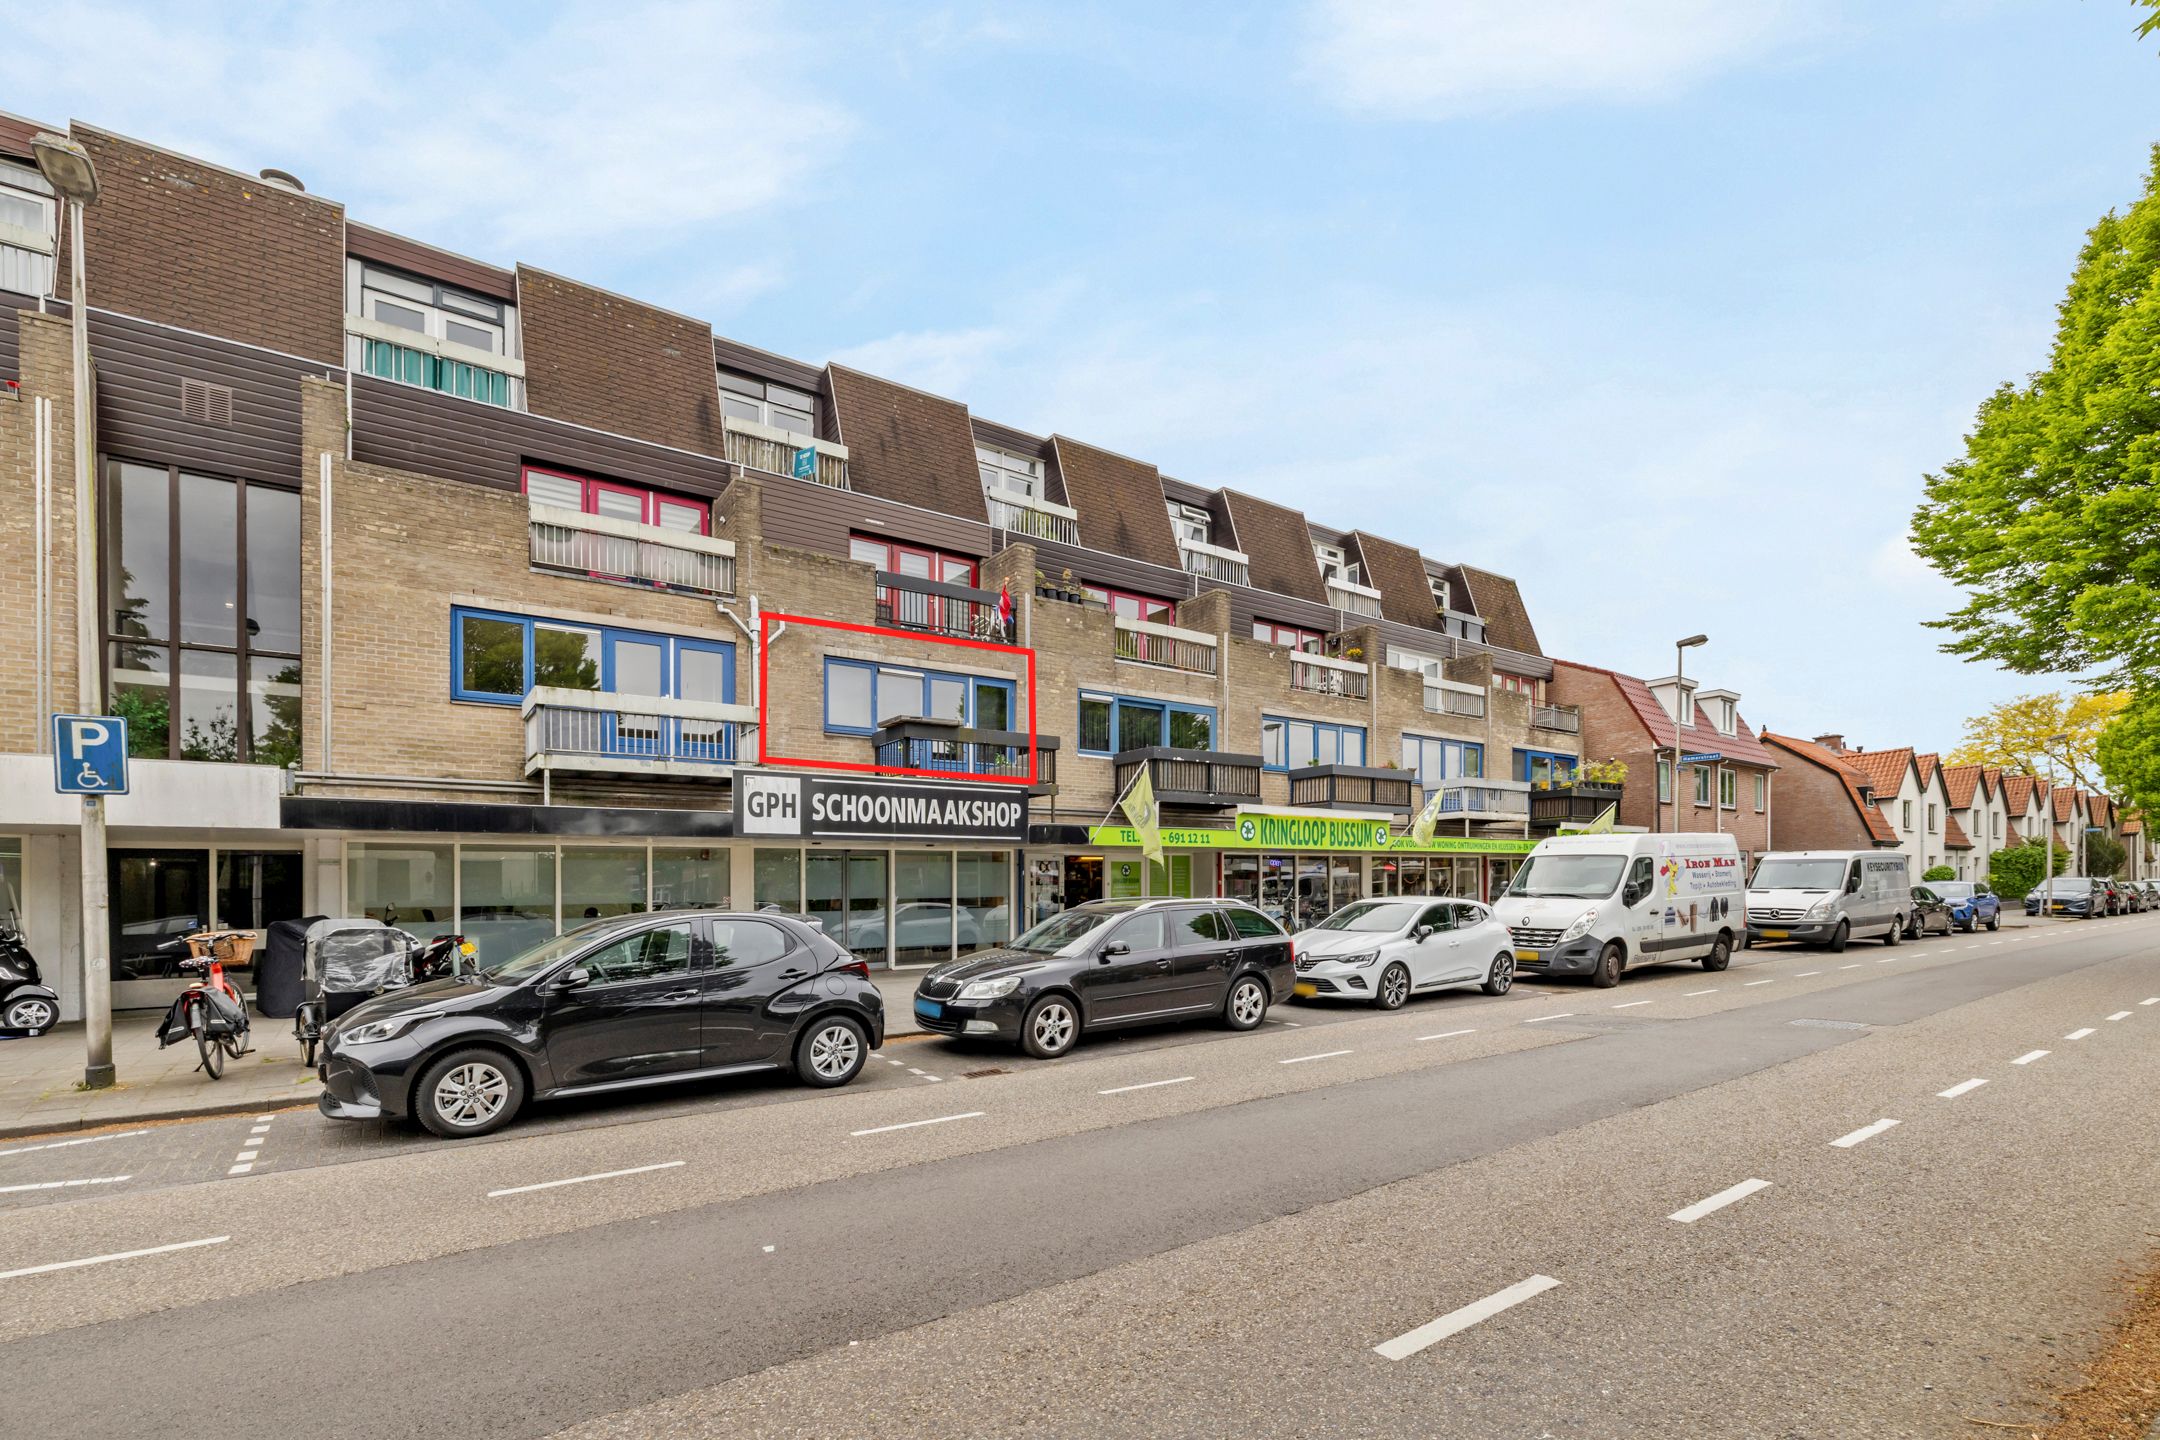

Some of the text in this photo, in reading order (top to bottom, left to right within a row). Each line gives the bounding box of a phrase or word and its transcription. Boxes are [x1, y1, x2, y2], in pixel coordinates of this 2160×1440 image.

[71, 721, 109, 760] P
[747, 791, 797, 819] GPH
[812, 792, 1021, 828] SCHOONMAAKSHOP
[1120, 830, 1140, 843] TEL.
[1168, 832, 1186, 843] 691
[1188, 833, 1198, 844] 12
[1200, 834, 1210, 844] 11
[1260, 817, 1372, 848] KRINGLOOP BUSSUM
